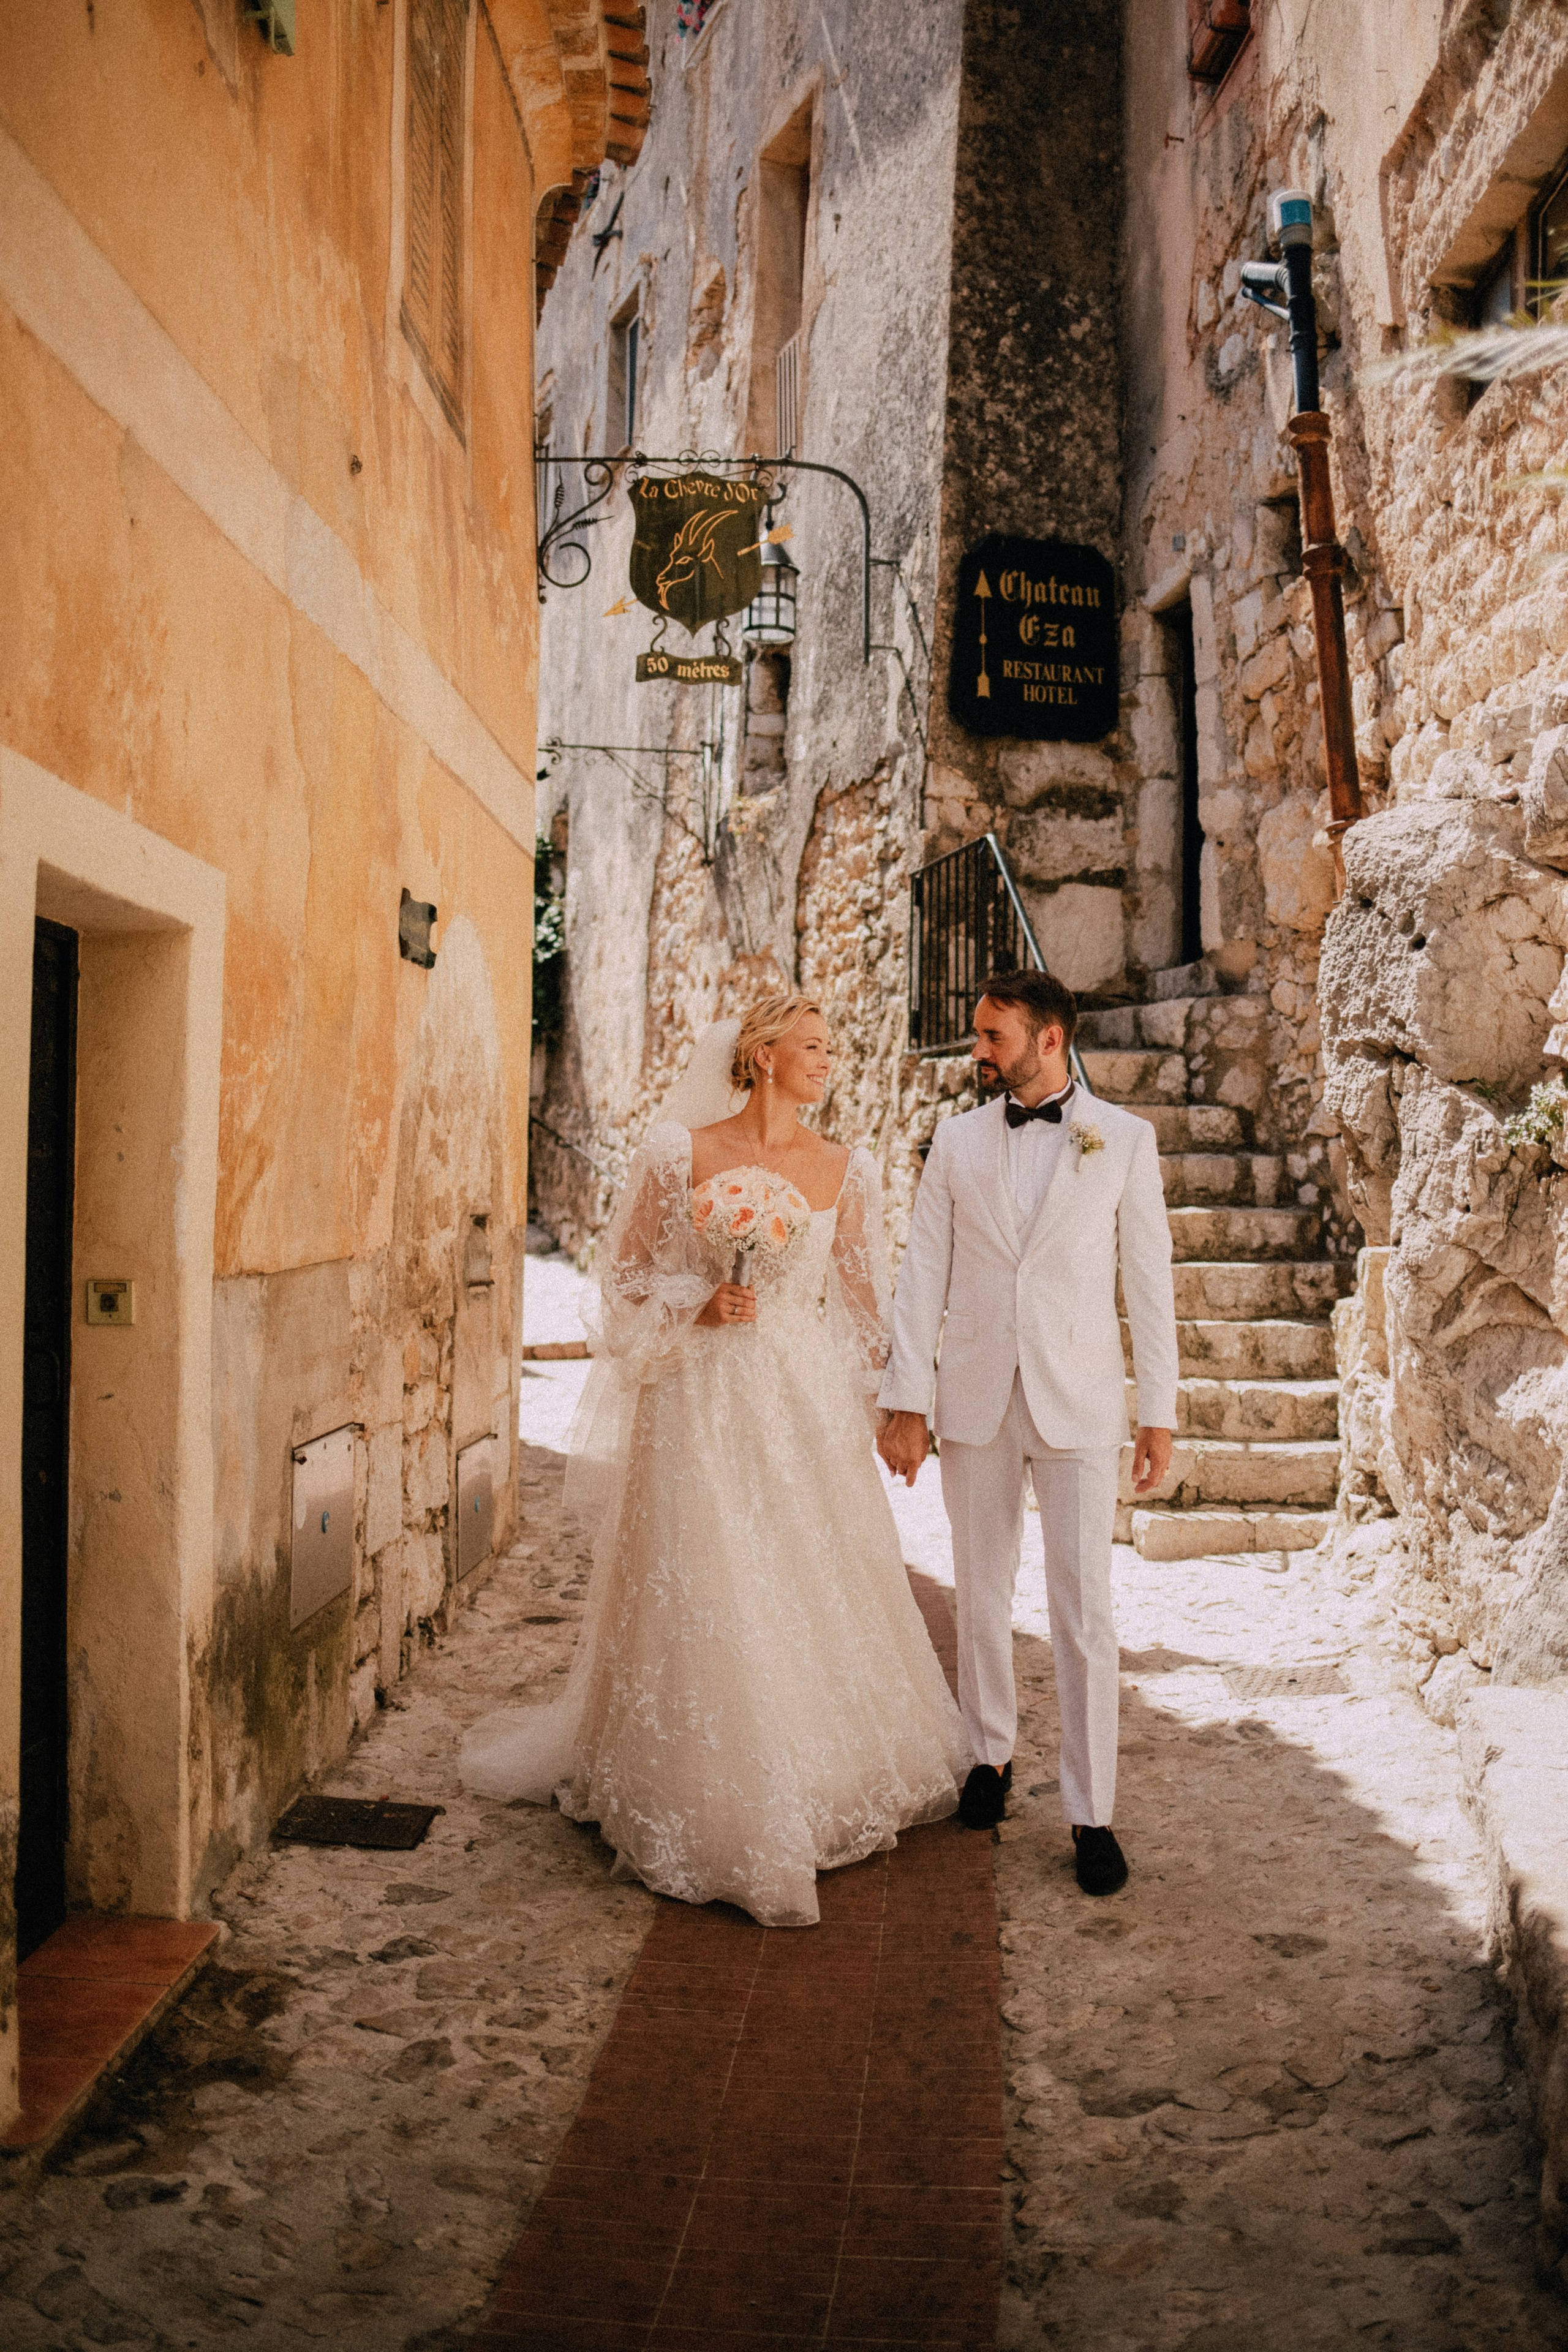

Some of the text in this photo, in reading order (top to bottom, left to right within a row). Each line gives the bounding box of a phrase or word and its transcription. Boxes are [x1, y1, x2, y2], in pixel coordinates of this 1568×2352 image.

[639, 477, 658, 498] La
[999, 569, 1100, 609] Chateau
[1019, 614, 1076, 648] Eza
[647, 656, 669, 673] 50
[1003, 660, 1104, 685] RESTAURANT
[1023, 684, 1078, 705] HOTEL
